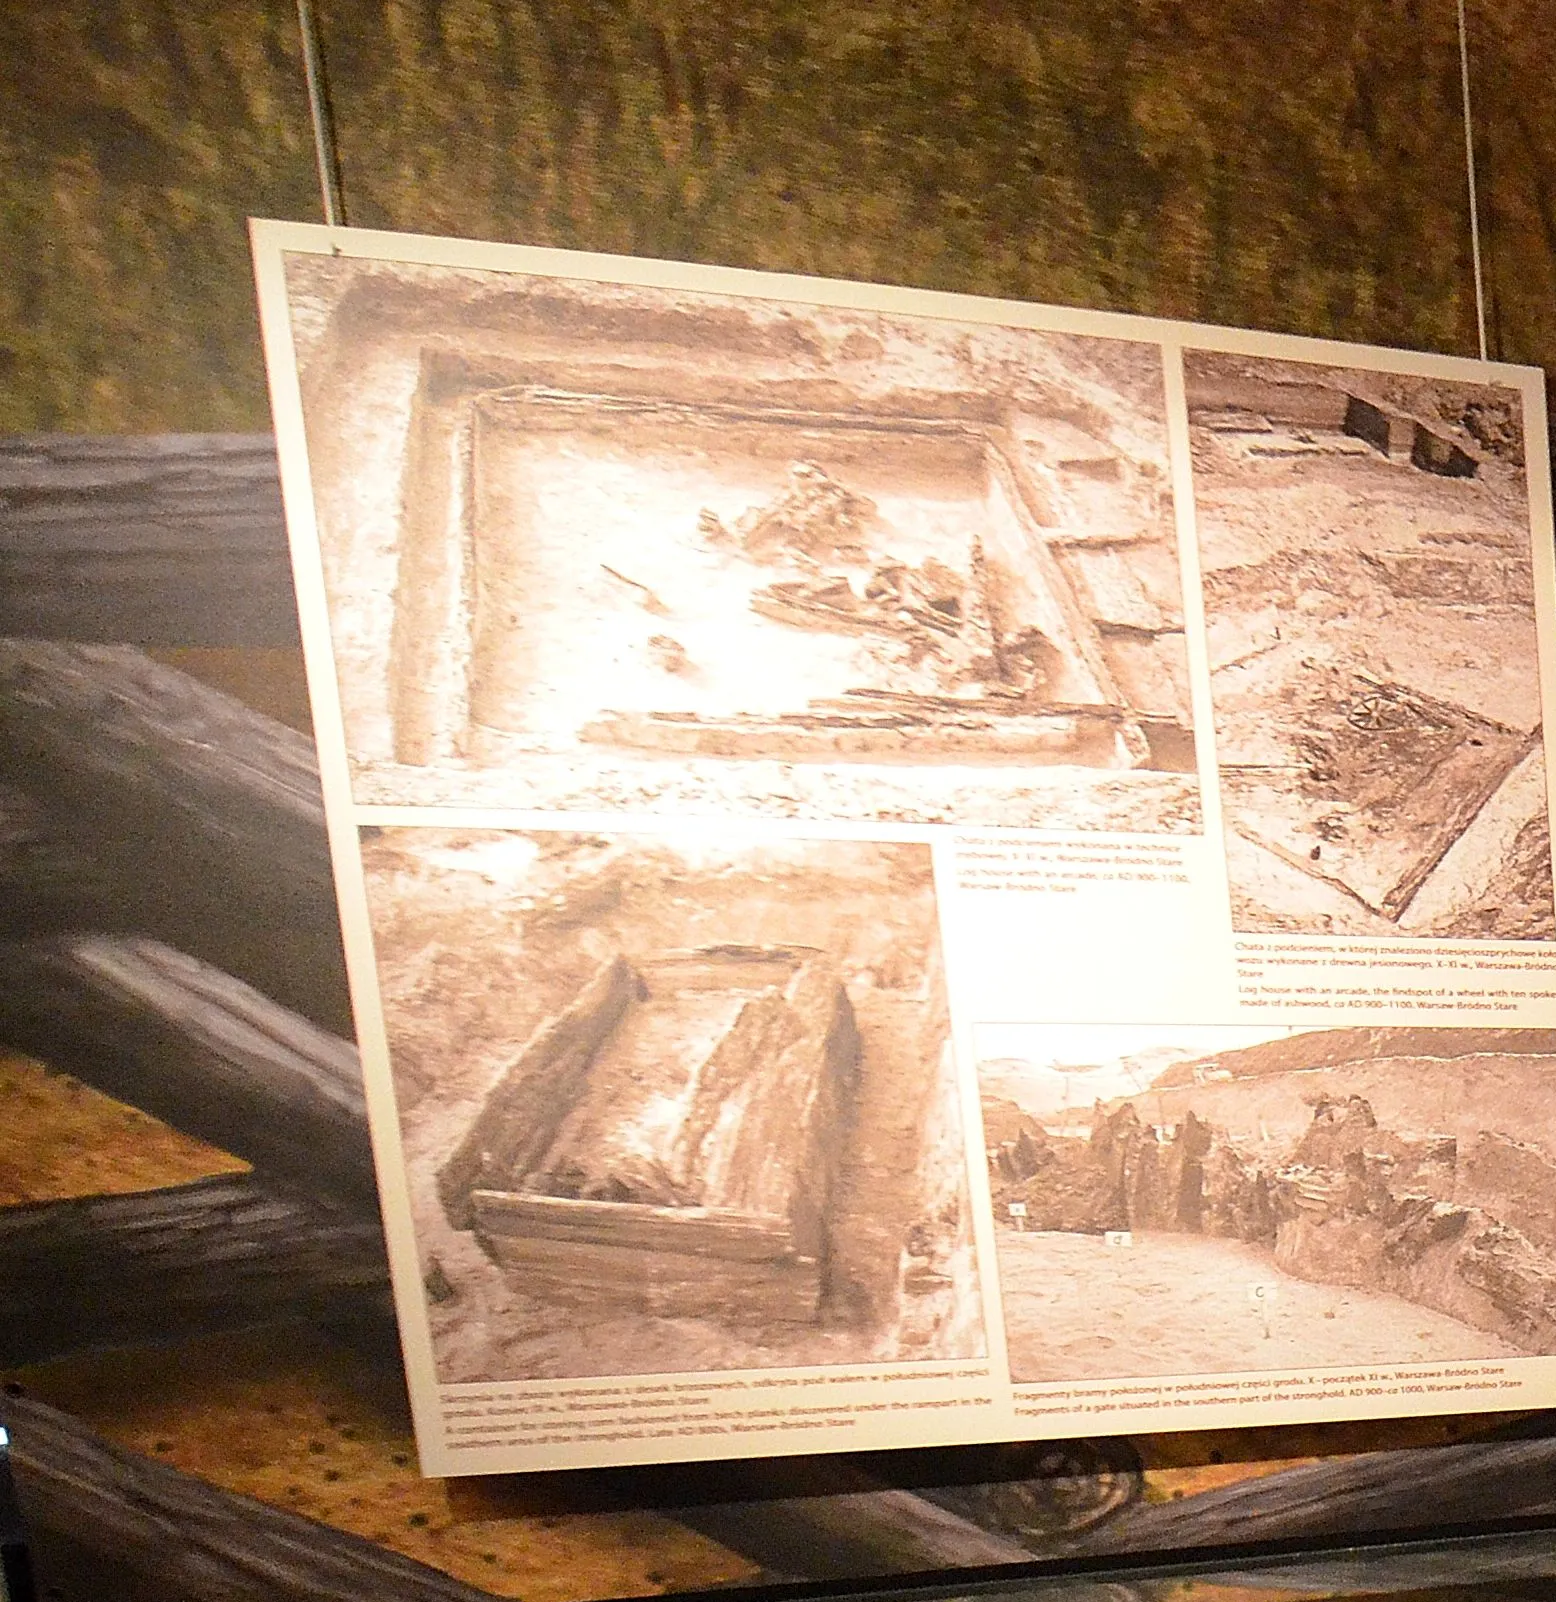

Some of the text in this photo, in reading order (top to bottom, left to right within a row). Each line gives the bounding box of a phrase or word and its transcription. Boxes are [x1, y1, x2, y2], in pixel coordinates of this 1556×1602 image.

[1238, 985, 1258, 995] Log
[1260, 985, 1291, 994] house
[1295, 985, 1317, 994] with
[1373, 987, 1390, 996] the
[1456, 988, 1485, 997] wheel
[1487, 988, 1509, 997] with
[1510, 989, 1527, 998] ten
[1480, 1366, 1505, 1375] Stare
[1239, 1394, 1260, 1406] part
[1274, 1393, 1290, 1401] the
[1499, 1380, 1523, 1389] Stare
